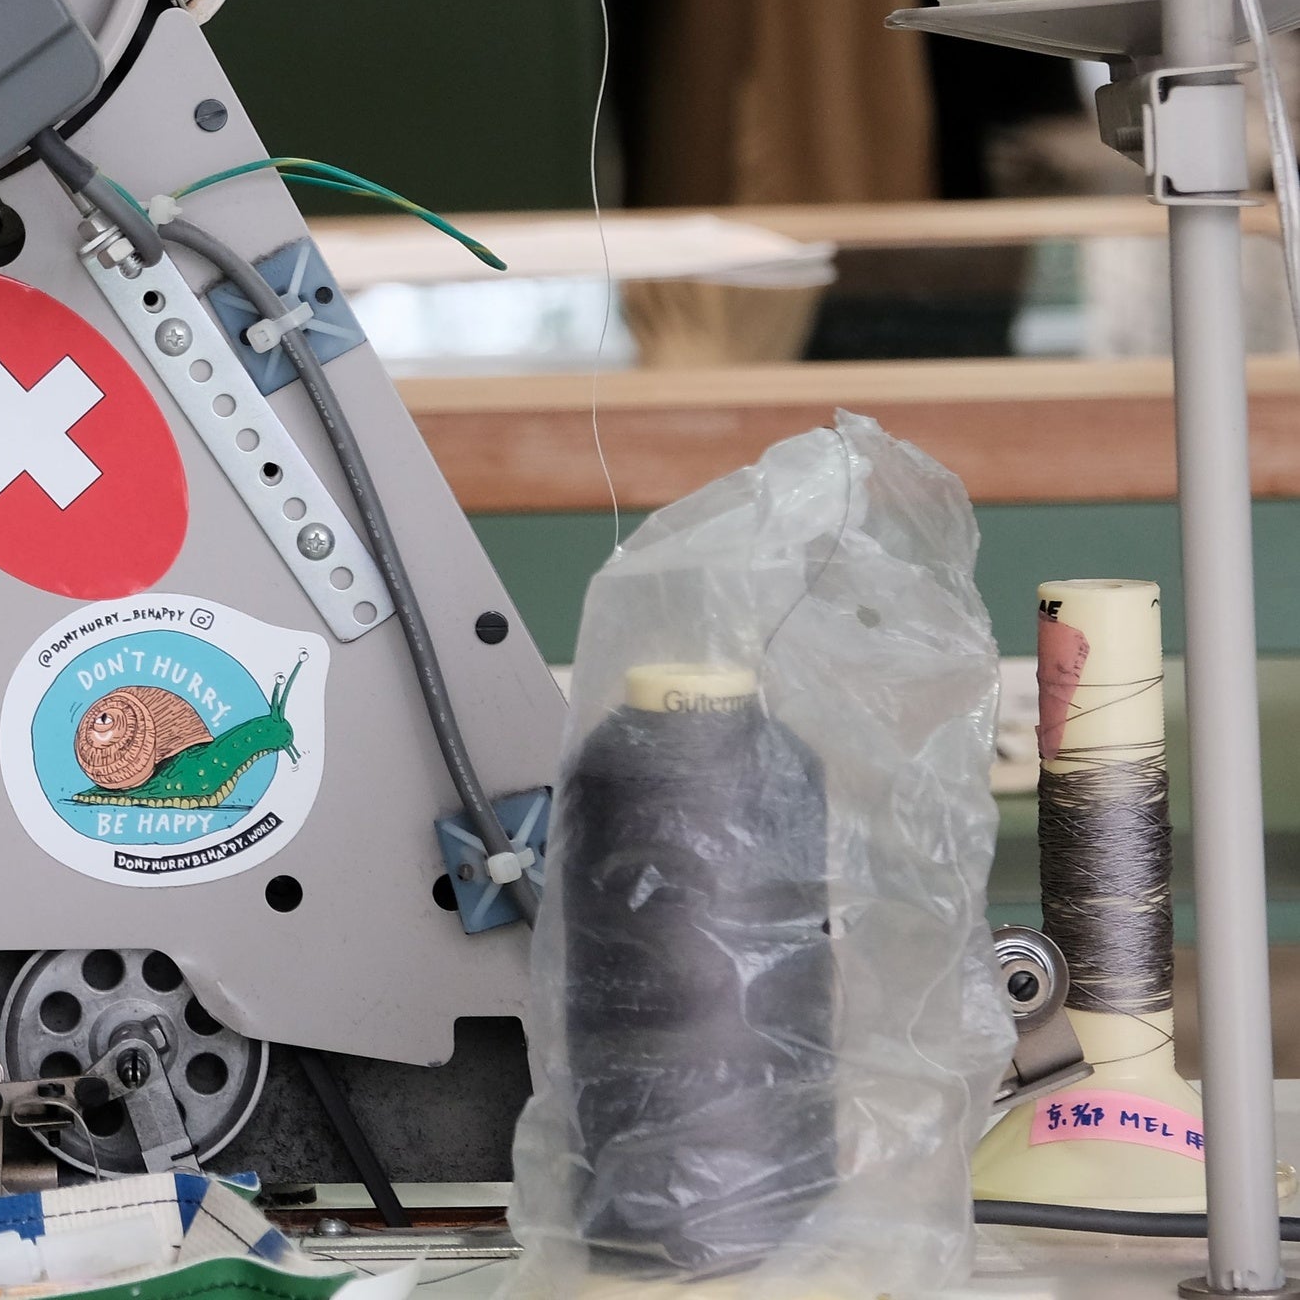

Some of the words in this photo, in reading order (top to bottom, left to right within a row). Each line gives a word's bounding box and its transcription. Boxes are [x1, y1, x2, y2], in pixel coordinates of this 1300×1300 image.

[77, 647, 145, 691] DON'T
[97, 812, 124, 836] BE
[137, 812, 215, 834] HAPPY
[1119, 1110, 1175, 1137] MEL
